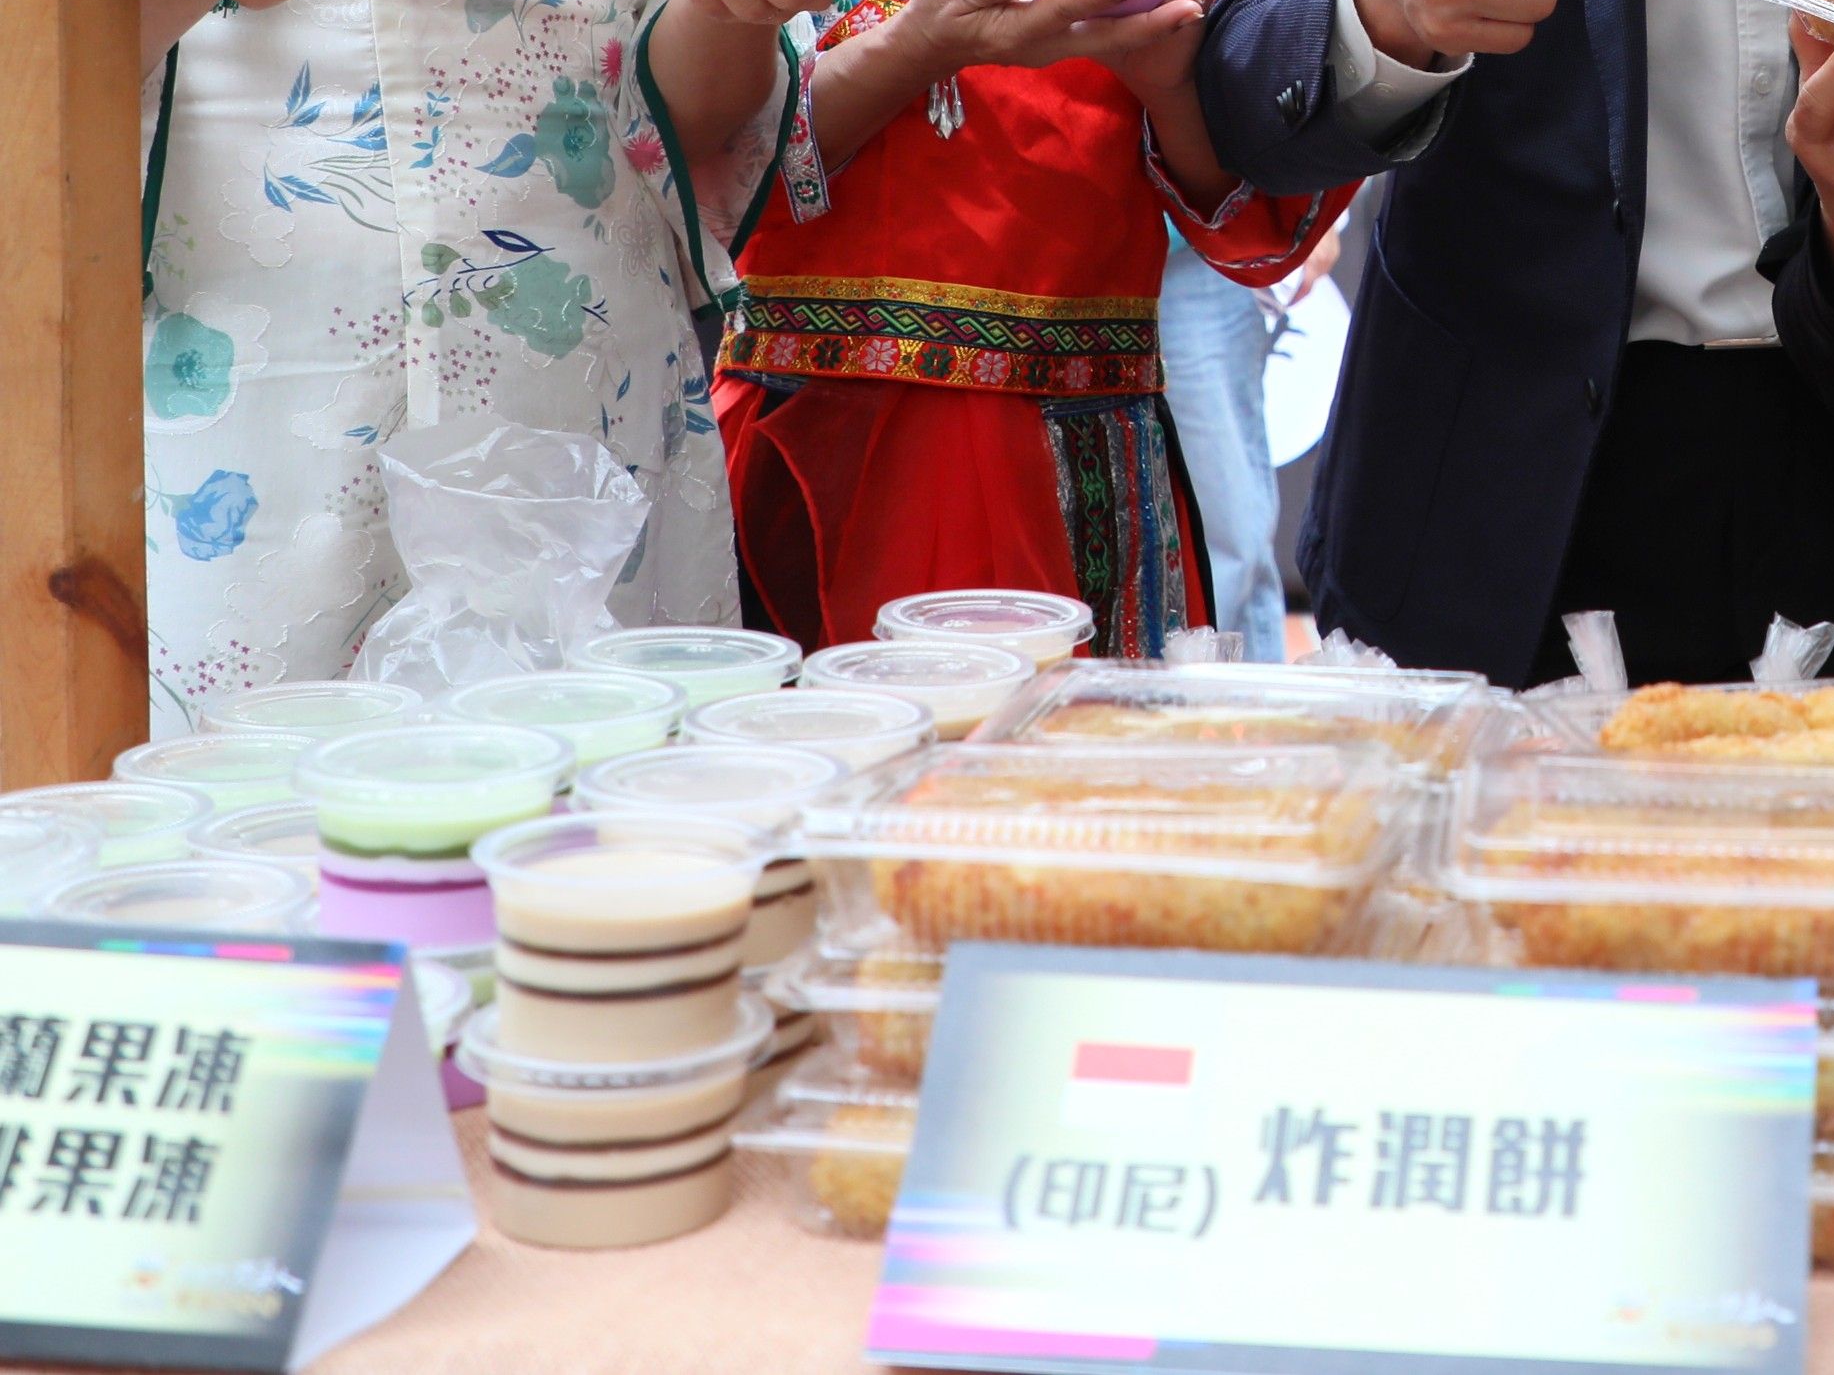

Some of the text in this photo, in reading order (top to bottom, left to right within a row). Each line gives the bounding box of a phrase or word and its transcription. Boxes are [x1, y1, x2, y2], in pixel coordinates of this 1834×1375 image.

[1003, 1106, 1588, 1237] (印尼) 炸潤餅
